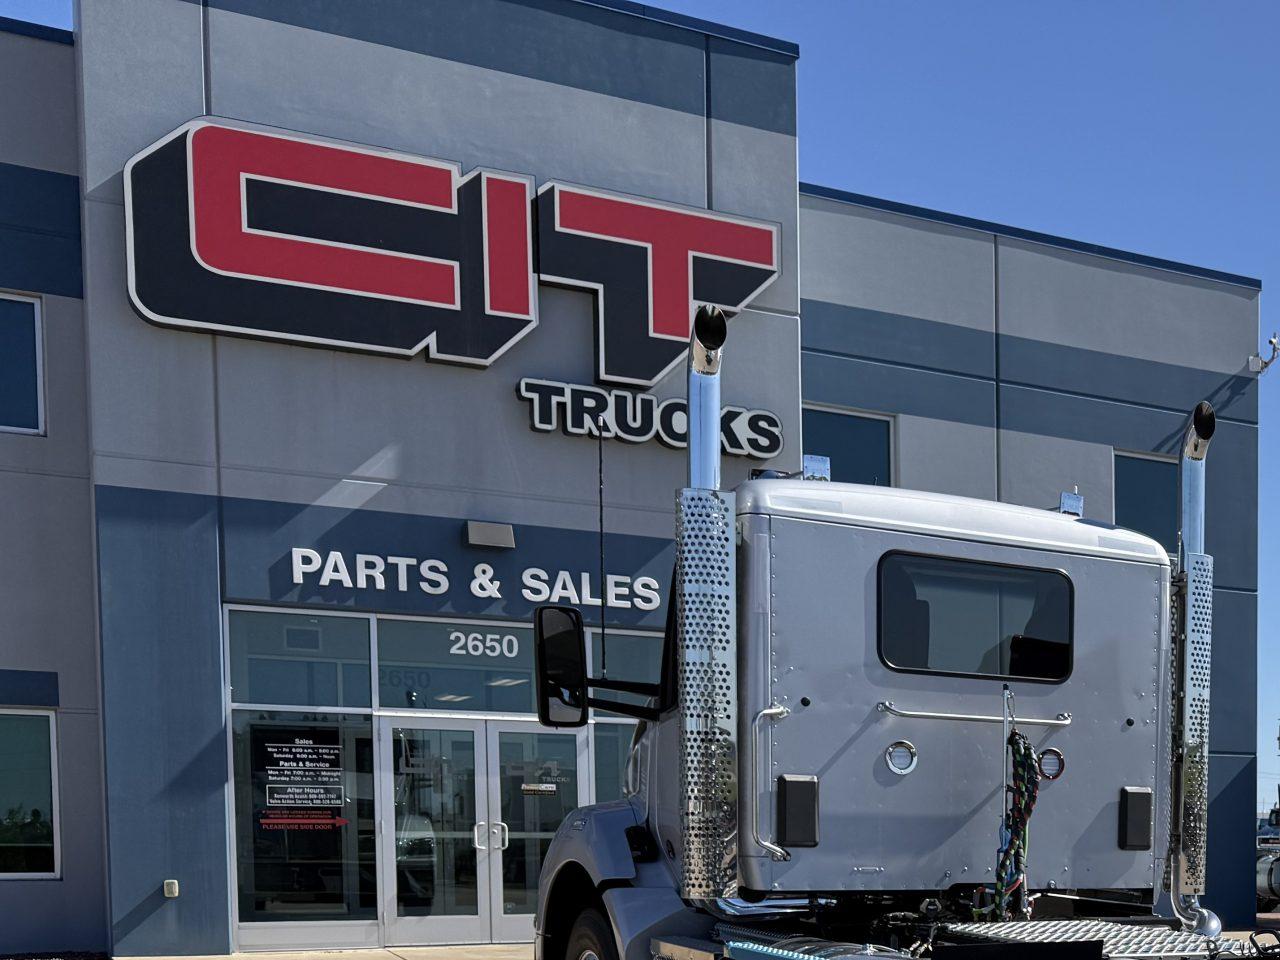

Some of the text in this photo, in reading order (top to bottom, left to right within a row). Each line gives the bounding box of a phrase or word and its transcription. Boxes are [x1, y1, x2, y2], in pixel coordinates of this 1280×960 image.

[125, 116, 781, 387] CIT
[517, 378, 784, 459] TRUCKS
[292, 548, 661, 611] PARTS & SALES
[449, 631, 519, 658] 2650
